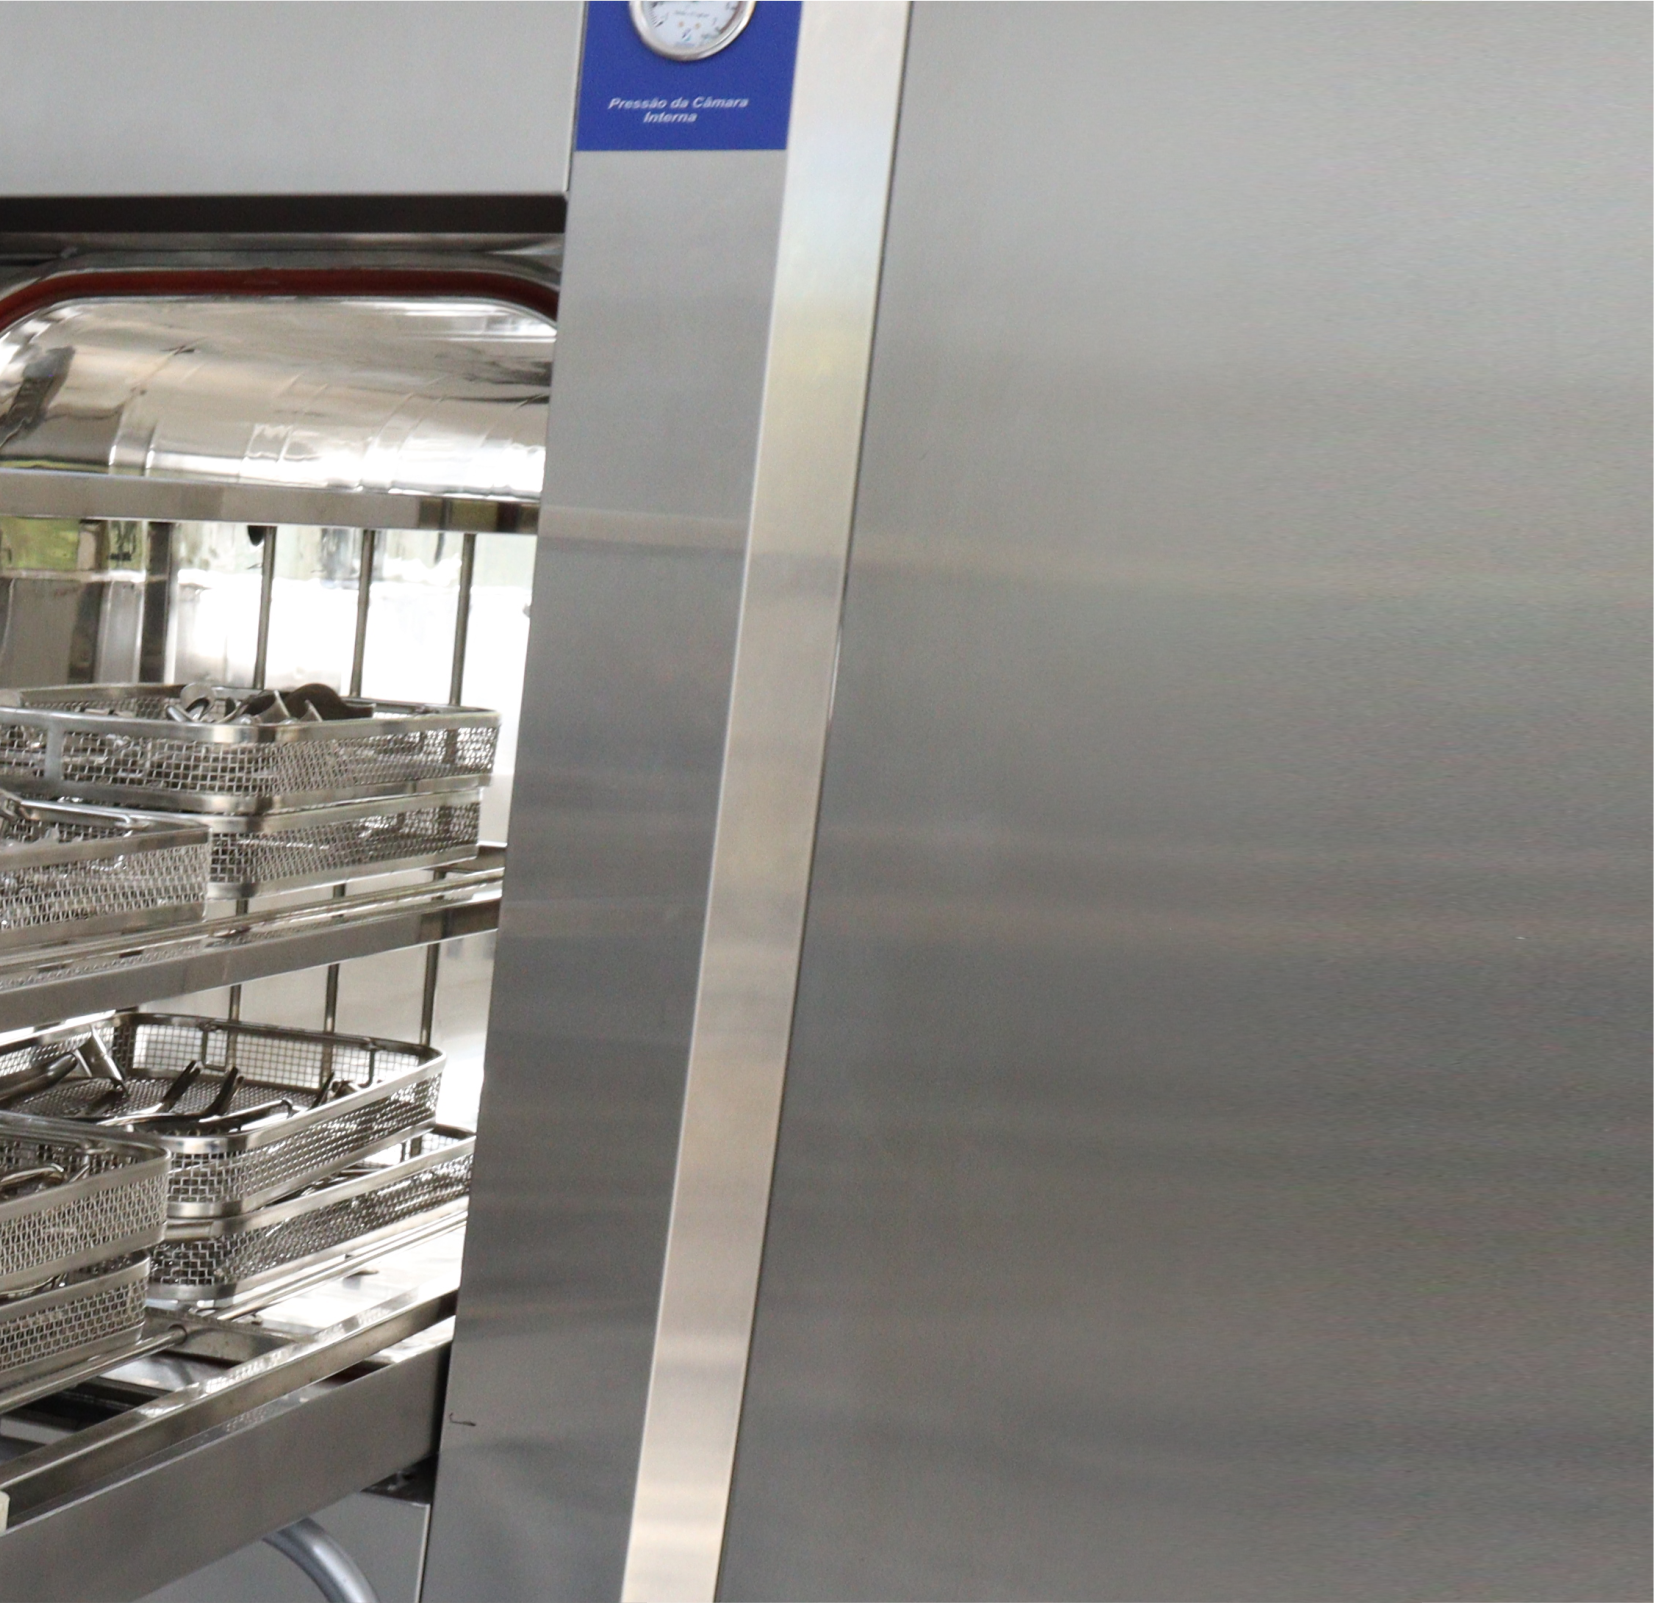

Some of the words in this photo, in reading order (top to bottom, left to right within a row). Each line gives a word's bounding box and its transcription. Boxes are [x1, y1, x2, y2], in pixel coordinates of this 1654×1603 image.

[670, 96, 690, 109] da
[693, 95, 750, 109] Câmara
[643, 111, 698, 123] Interna
